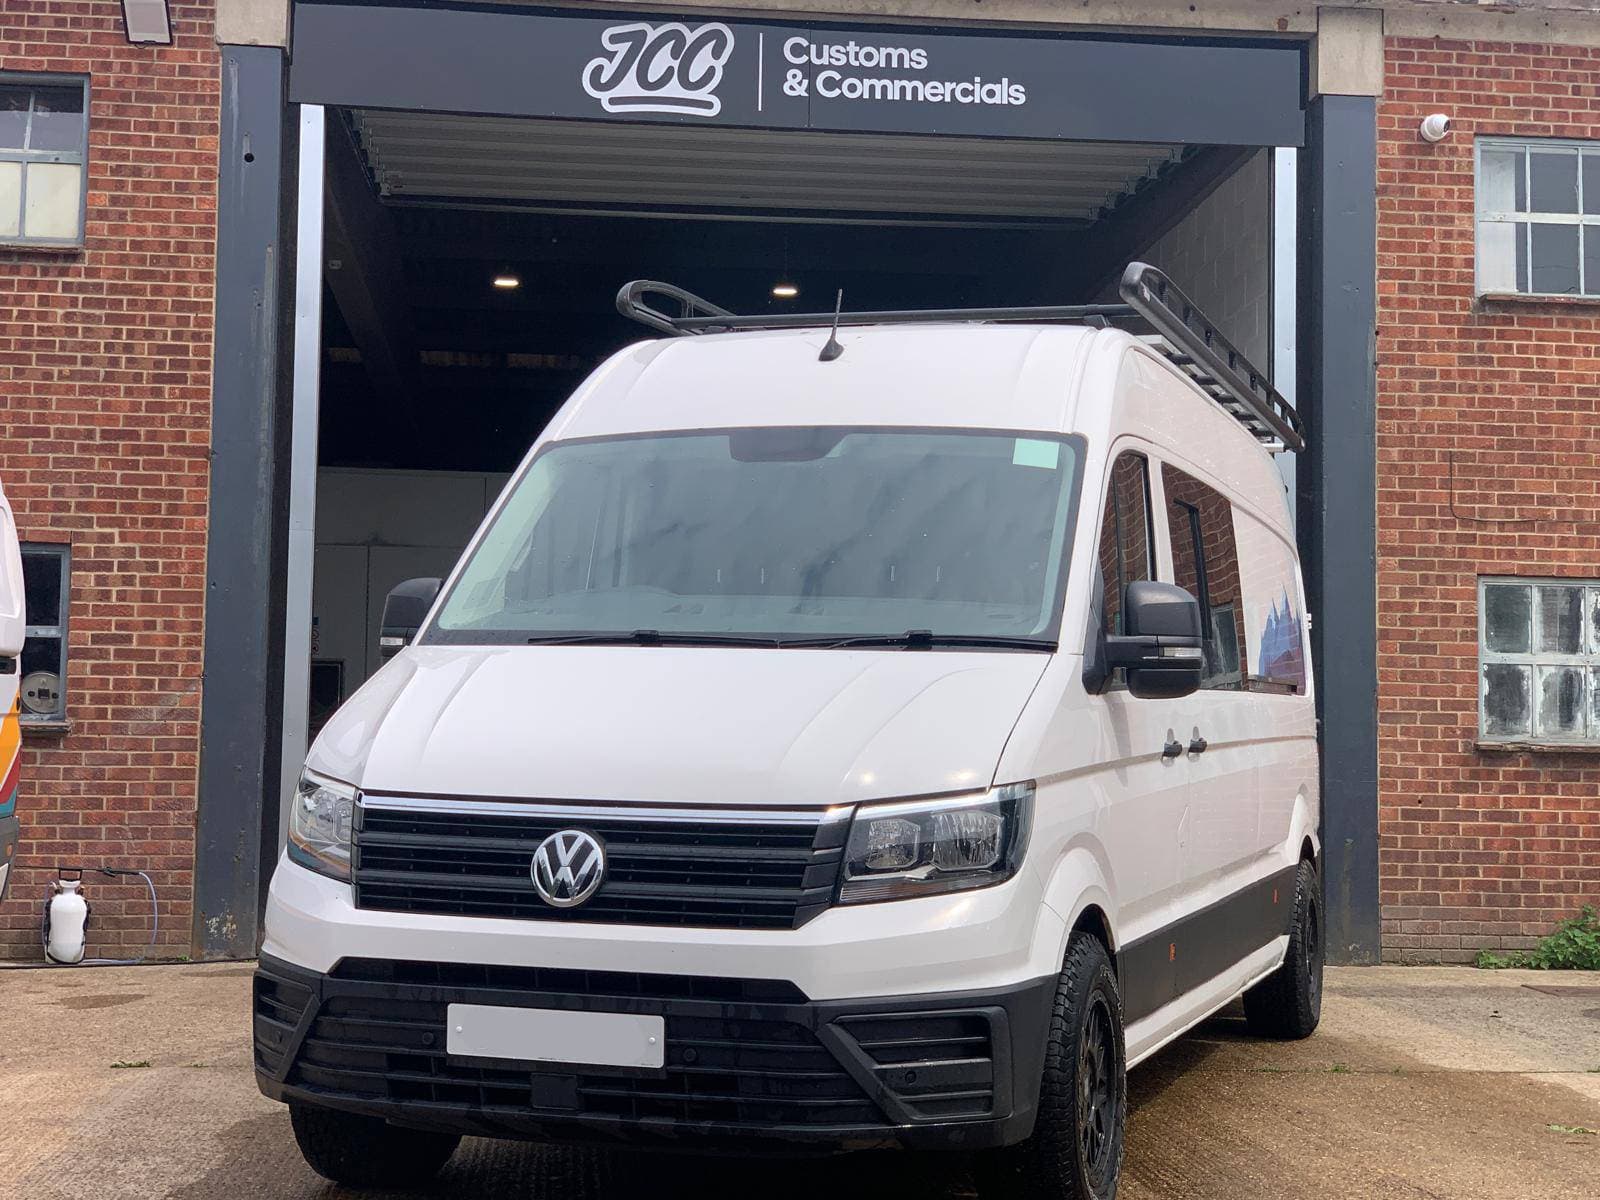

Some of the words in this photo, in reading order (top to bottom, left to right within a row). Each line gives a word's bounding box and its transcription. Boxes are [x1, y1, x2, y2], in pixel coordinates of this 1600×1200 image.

[583, 22, 734, 98] JCC
[783, 36, 928, 70] Customs
[783, 69, 808, 97] &
[815, 70, 1026, 106] Commercials
[531, 829, 604, 908] VW
